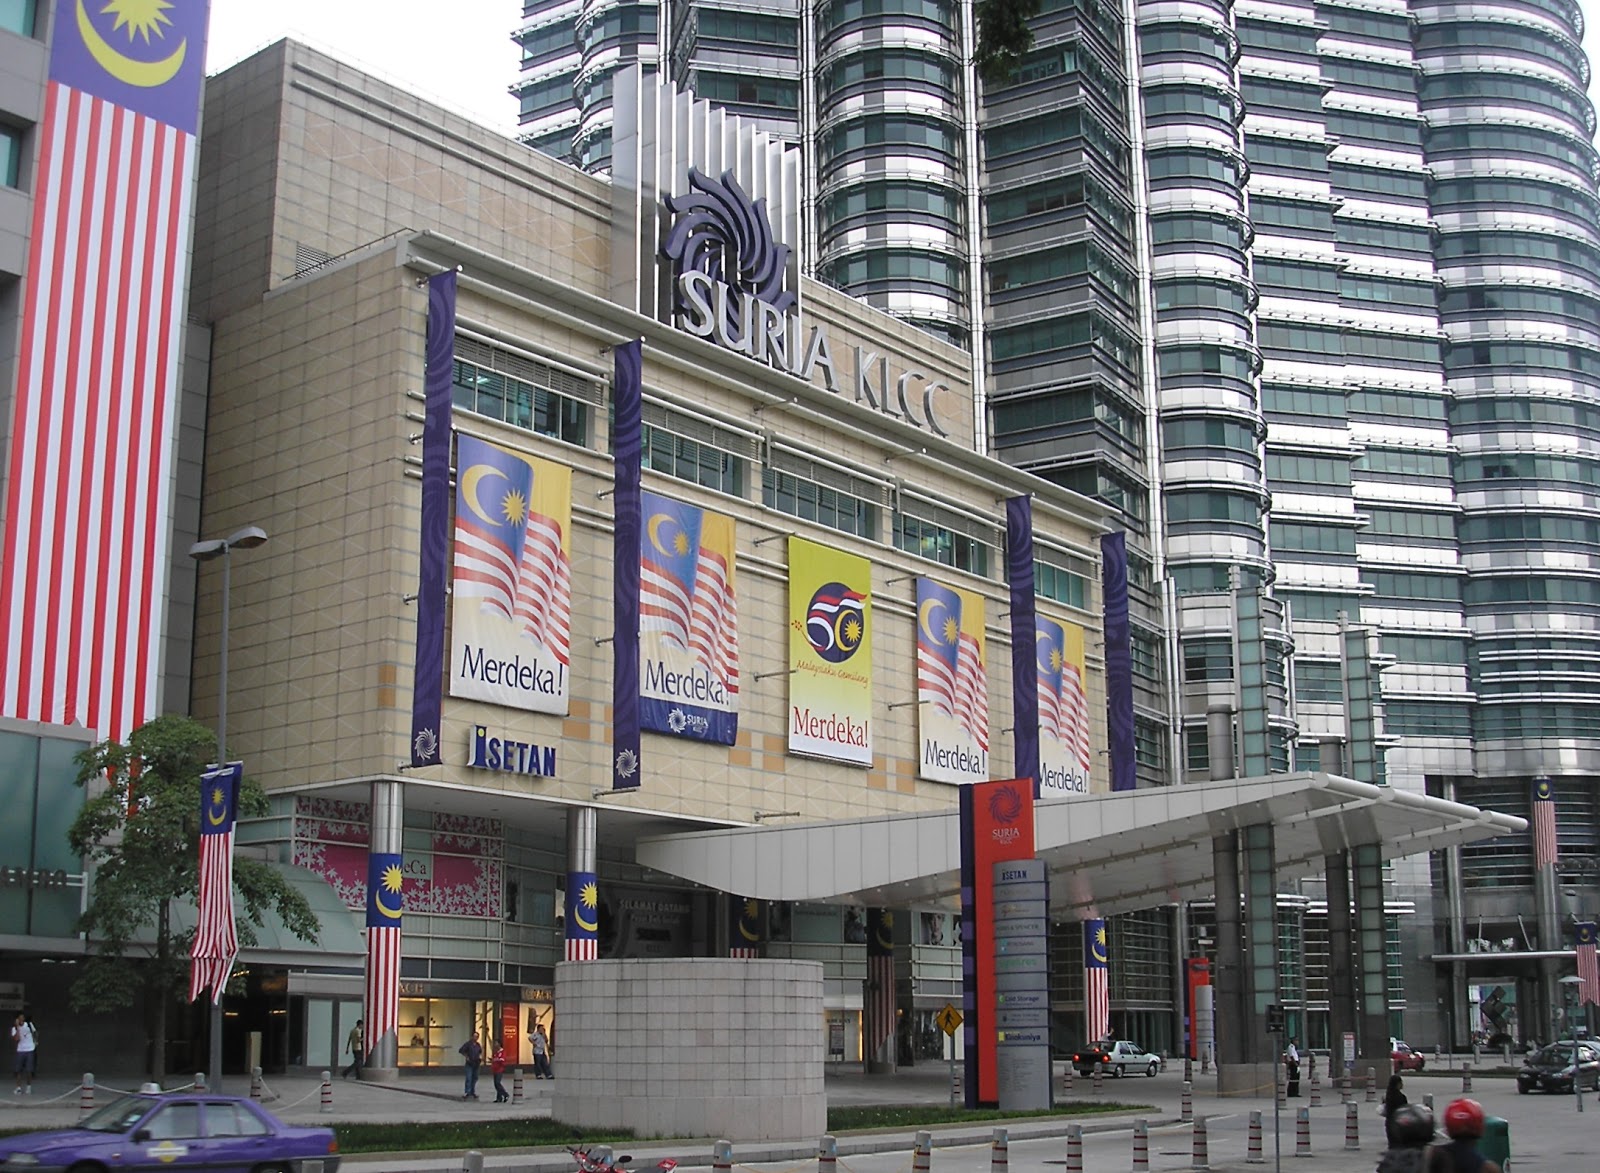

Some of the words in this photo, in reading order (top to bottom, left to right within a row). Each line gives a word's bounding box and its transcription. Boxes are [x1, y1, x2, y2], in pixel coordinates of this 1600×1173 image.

[677, 269, 840, 393] SURIA
[854, 345, 950, 438] KLCC
[461, 644, 563, 696] Merdeka!
[645, 659, 729, 706] Merdeka!
[687, 714, 709, 727] SURIA
[793, 706, 868, 748] Merdeka!
[467, 725, 556, 777] ISETAN
[925, 738, 986, 775] Merdeka!
[992, 827, 1020, 838] SURIA
[402, 859, 426, 874] eCa
[1017, 994, 1039, 1003] Storage
[1005, 1032, 1041, 1042] Kinokuniya
